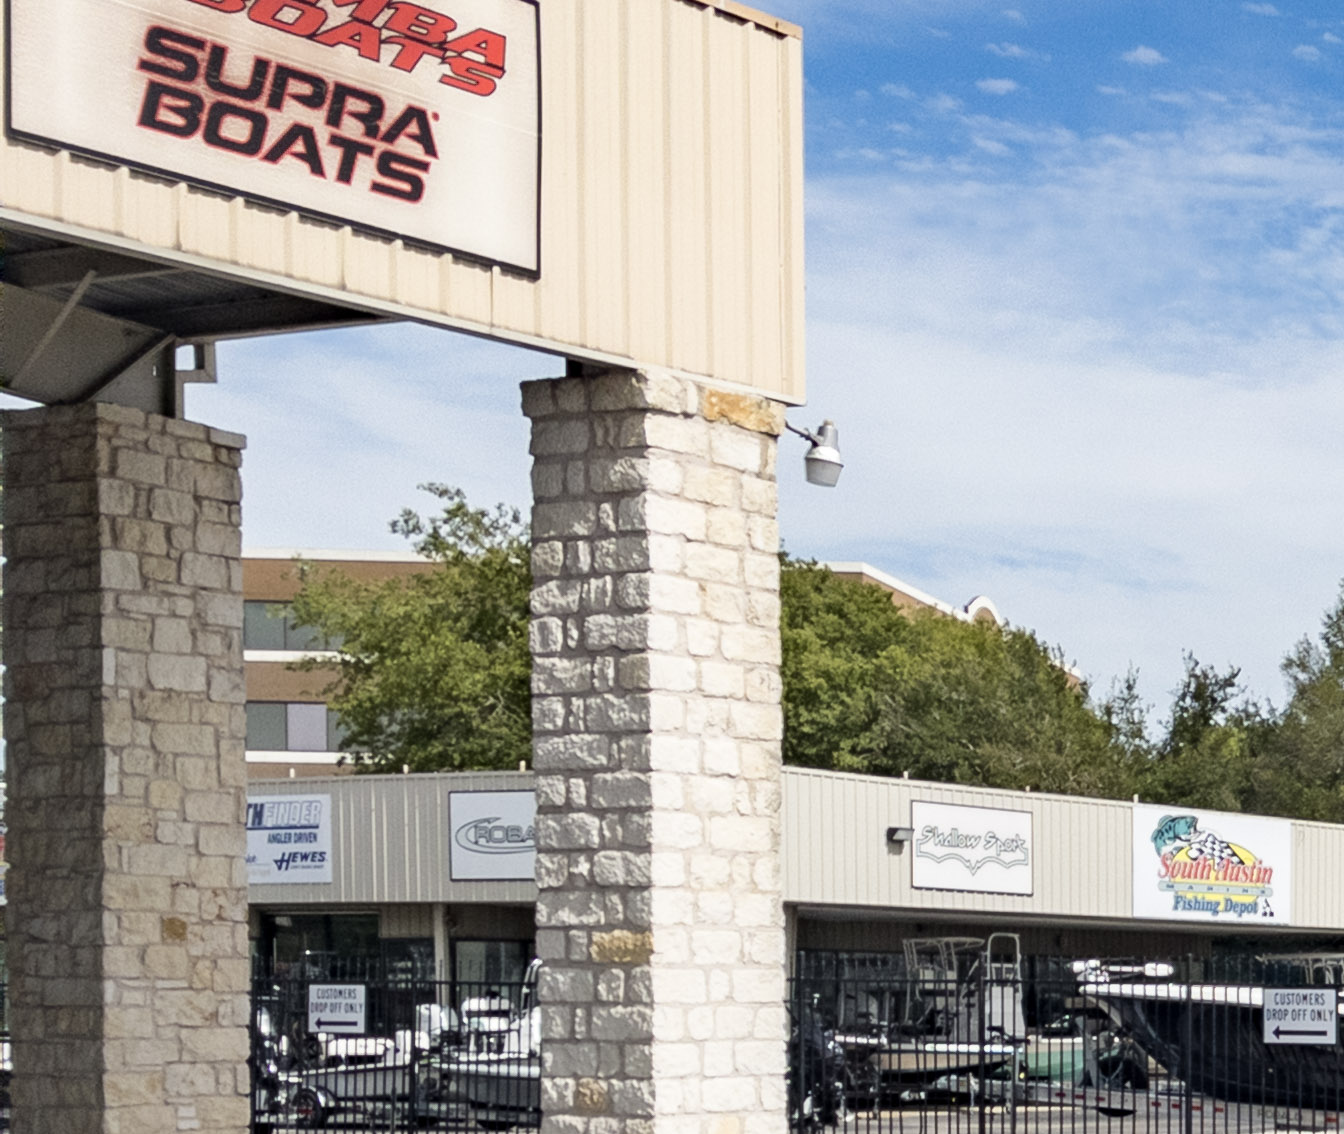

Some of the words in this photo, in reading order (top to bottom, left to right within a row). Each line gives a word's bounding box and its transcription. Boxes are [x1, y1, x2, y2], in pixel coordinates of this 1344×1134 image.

[137, 24, 439, 160] SUPRA
[136, 79, 432, 204] BOATS
[267, 832, 292, 844] ANGLER
[294, 832, 318, 843] DRIVEN
[474, 824, 536, 844] ROBA
[921, 825, 982, 849] Shallow
[983, 830, 1026, 857] Sport
[273, 851, 327, 871] HEWES
[1158, 851, 1213, 880] South
[1213, 857, 1274, 886] Austin
[1171, 893, 1221, 916] Fishing
[1223, 896, 1260, 918] Depot
[316, 988, 357, 1000] CUSTOMERS
[1274, 992, 1326, 1006] CUSTOMERS
[310, 1002, 328, 1014] DROP
[329, 1002, 342, 1014] OFF
[344, 1002, 363, 1014] ONLY
[1265, 1008, 1289, 1022] DROP
[1290, 1008, 1308, 1022] OFF
[1310, 1009, 1334, 1022] ONLY
